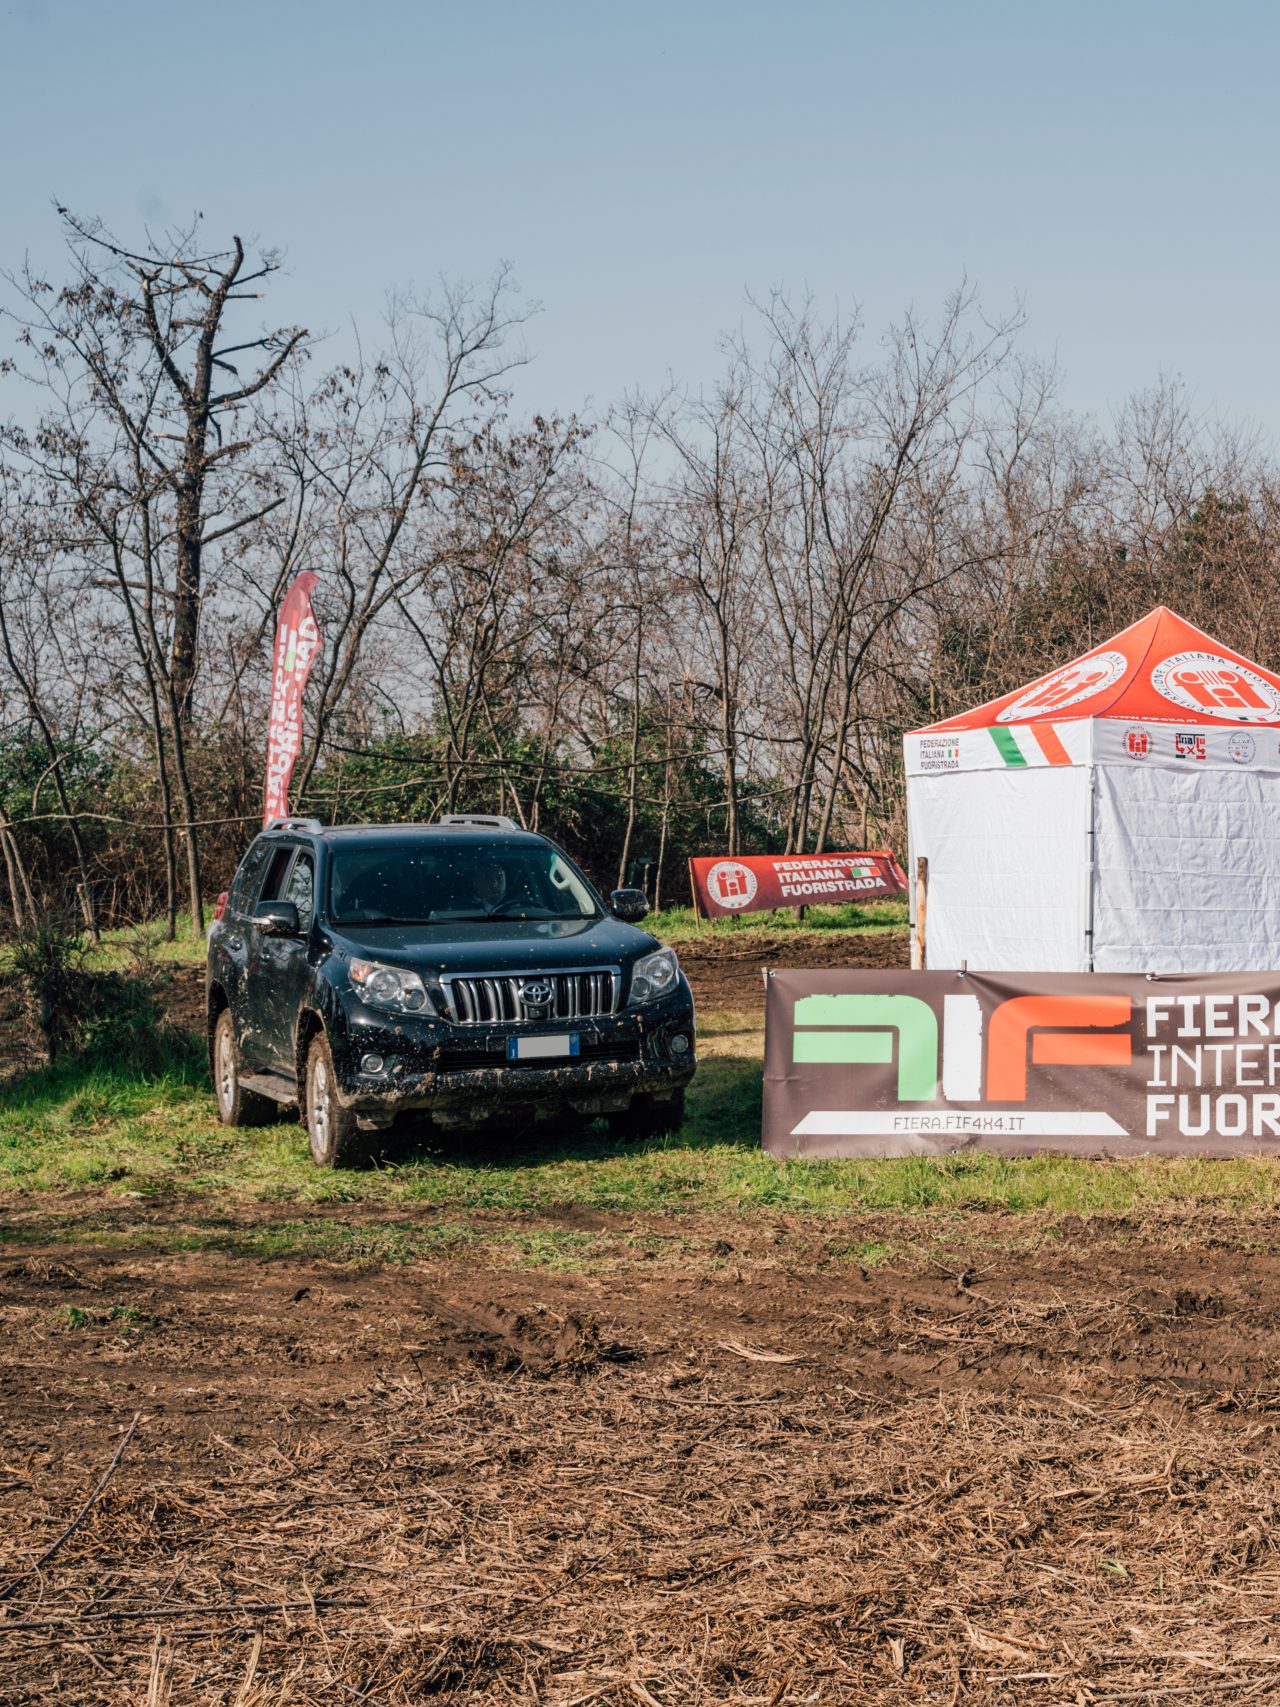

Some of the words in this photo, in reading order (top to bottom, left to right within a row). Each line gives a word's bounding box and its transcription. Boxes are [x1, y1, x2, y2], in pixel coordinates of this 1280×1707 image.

[920, 738, 959, 748] FEDERAZIONE
[920, 750, 945, 758] ITALIANA
[920, 760, 959, 770] FUORISTRADA
[773, 857, 876, 872] FEDERAZIONE
[778, 869, 846, 884] ITALIANA
[781, 877, 887, 898] FUORISTRADA
[893, 1115, 1025, 1132] FIERA.FIF4X4.IT
